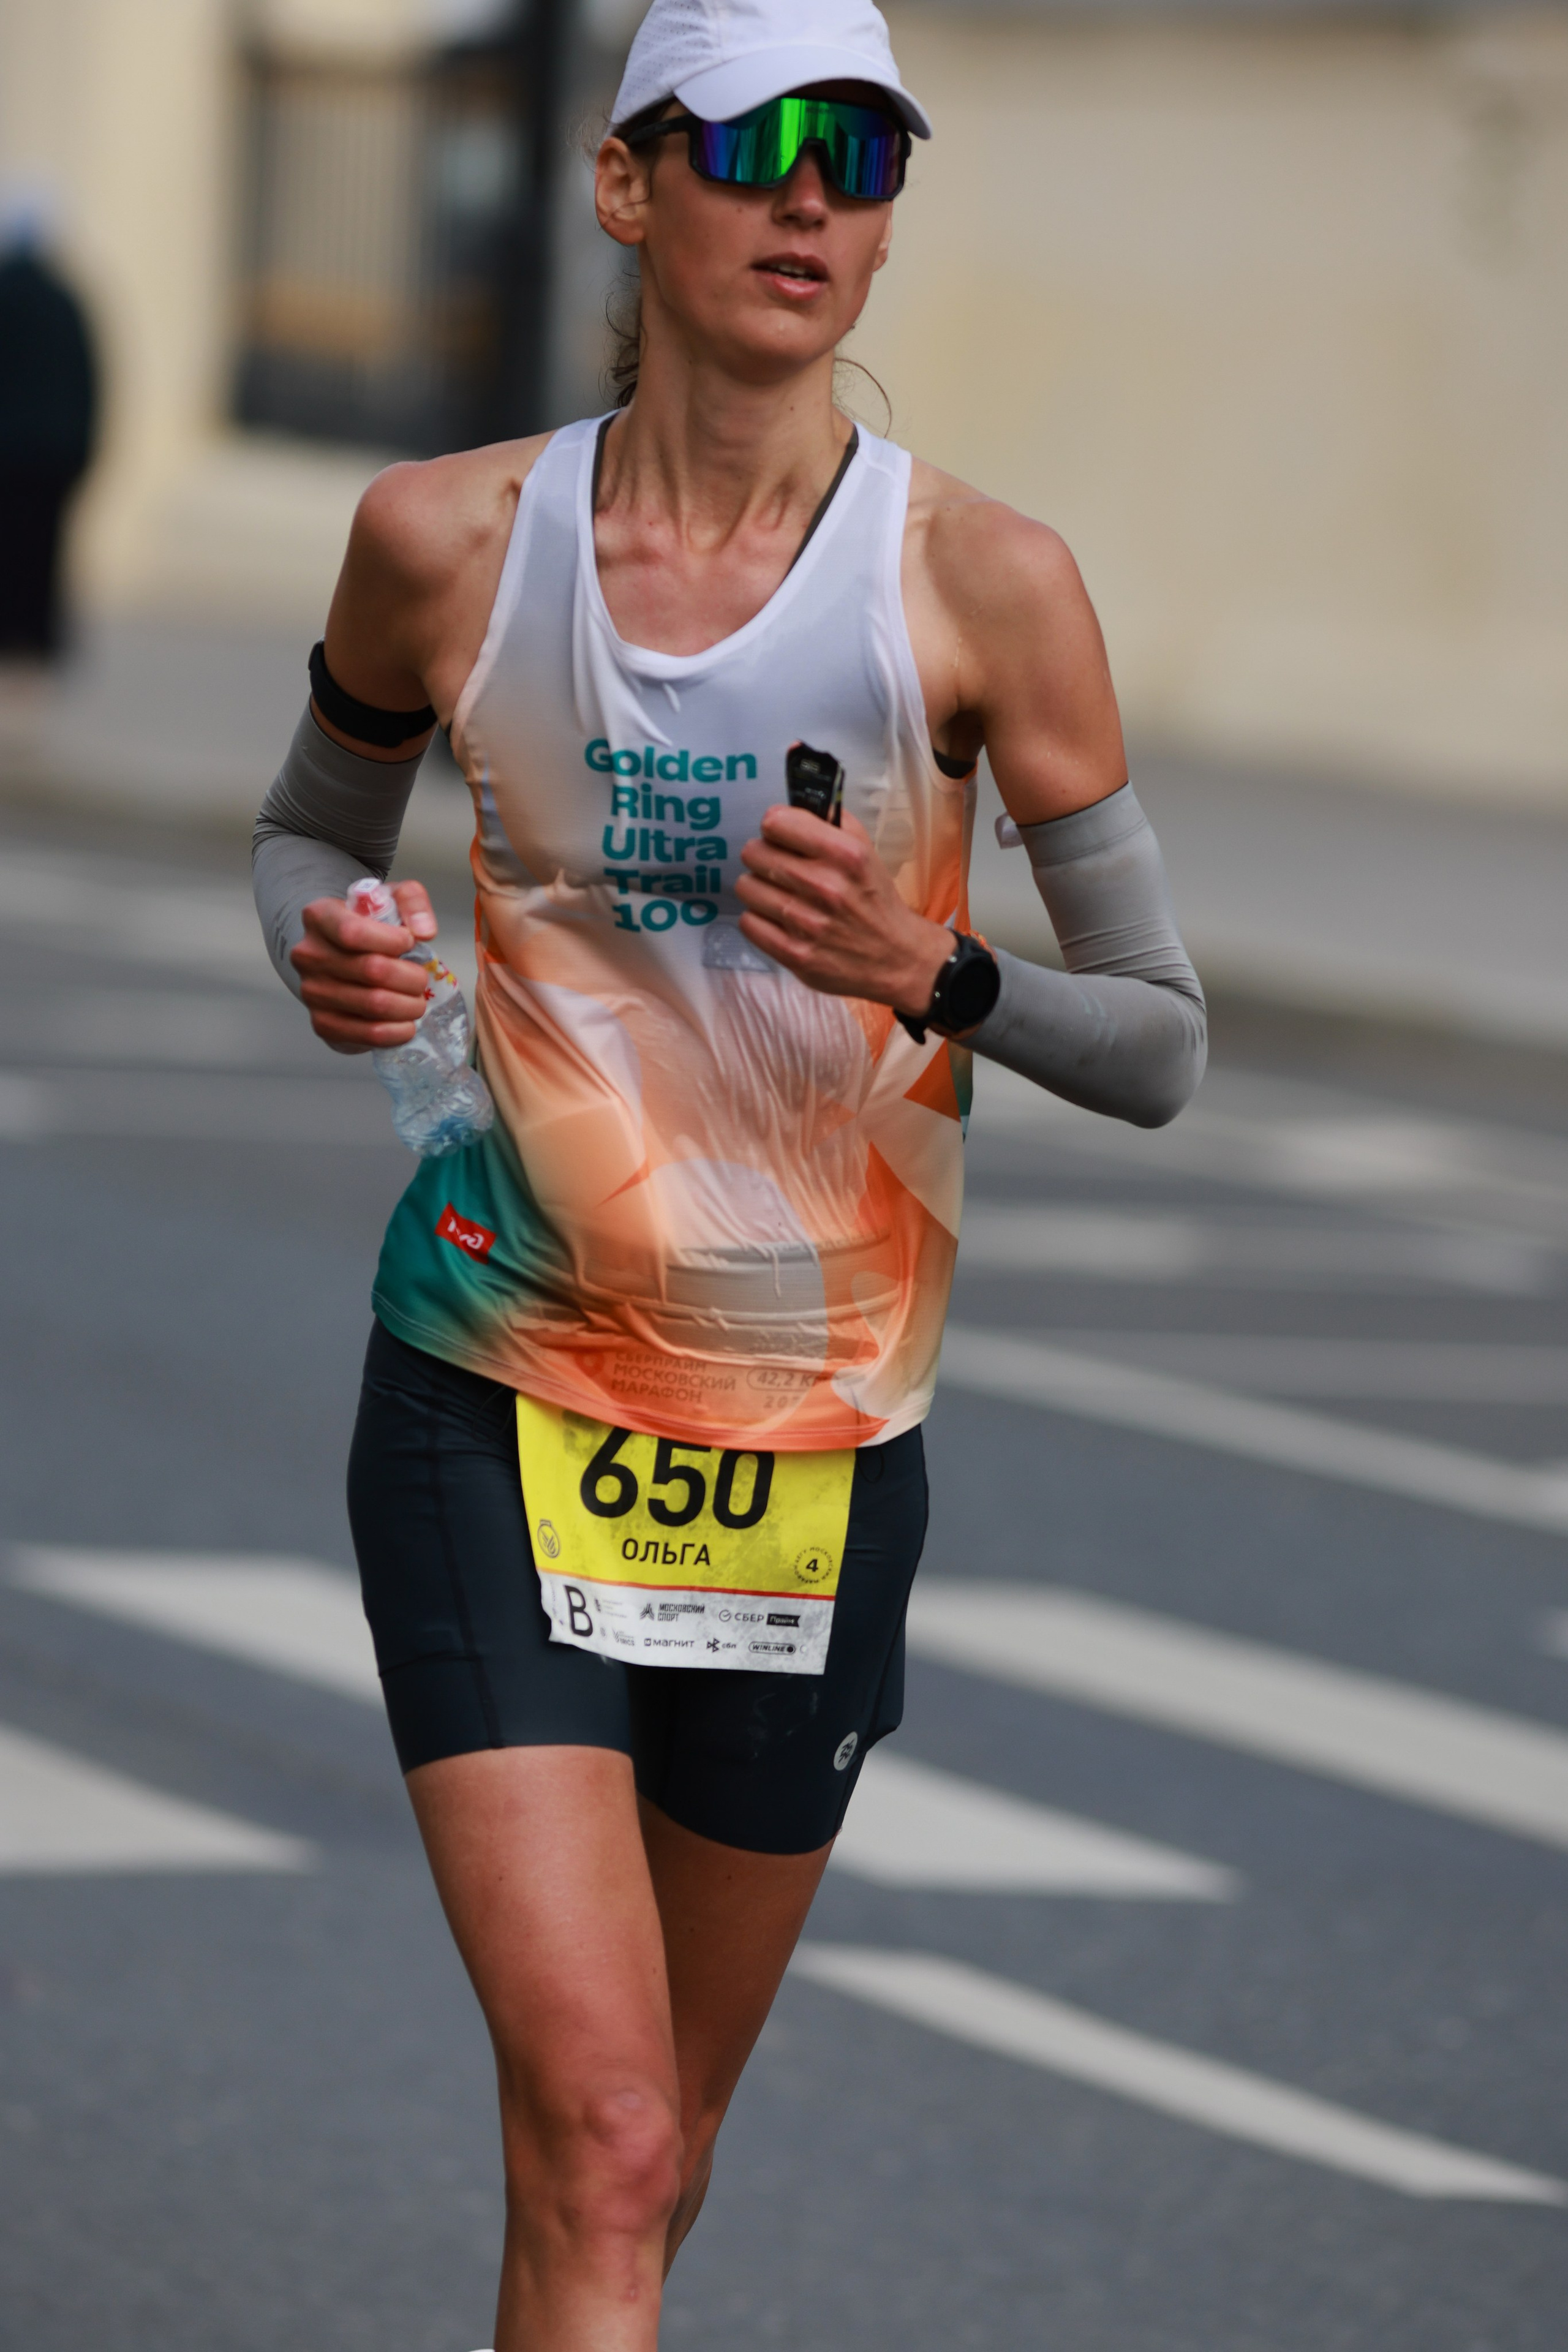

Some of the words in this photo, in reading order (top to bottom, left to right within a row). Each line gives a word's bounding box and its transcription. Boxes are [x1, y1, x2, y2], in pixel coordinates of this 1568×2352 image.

[584, 738, 758, 783] Golden
[611, 783, 722, 831] Ring
[601, 825, 728, 862] Ultra
[603, 865, 722, 895] Trail
[612, 899, 718, 932] 100
[614, 1363, 736, 1390] МОСКОВСКИЙ
[611, 1379, 703, 1403] МАРАФОН
[579, 1426, 774, 1529] 650
[622, 1538, 710, 1566] ОЛЬГА
[806, 1559, 818, 1572] 4
[657, 1613, 679, 1621] СПОРТ
[659, 1603, 705, 1614] МОСКОВСКИЙ
[734, 1612, 764, 1623] СБЕР
